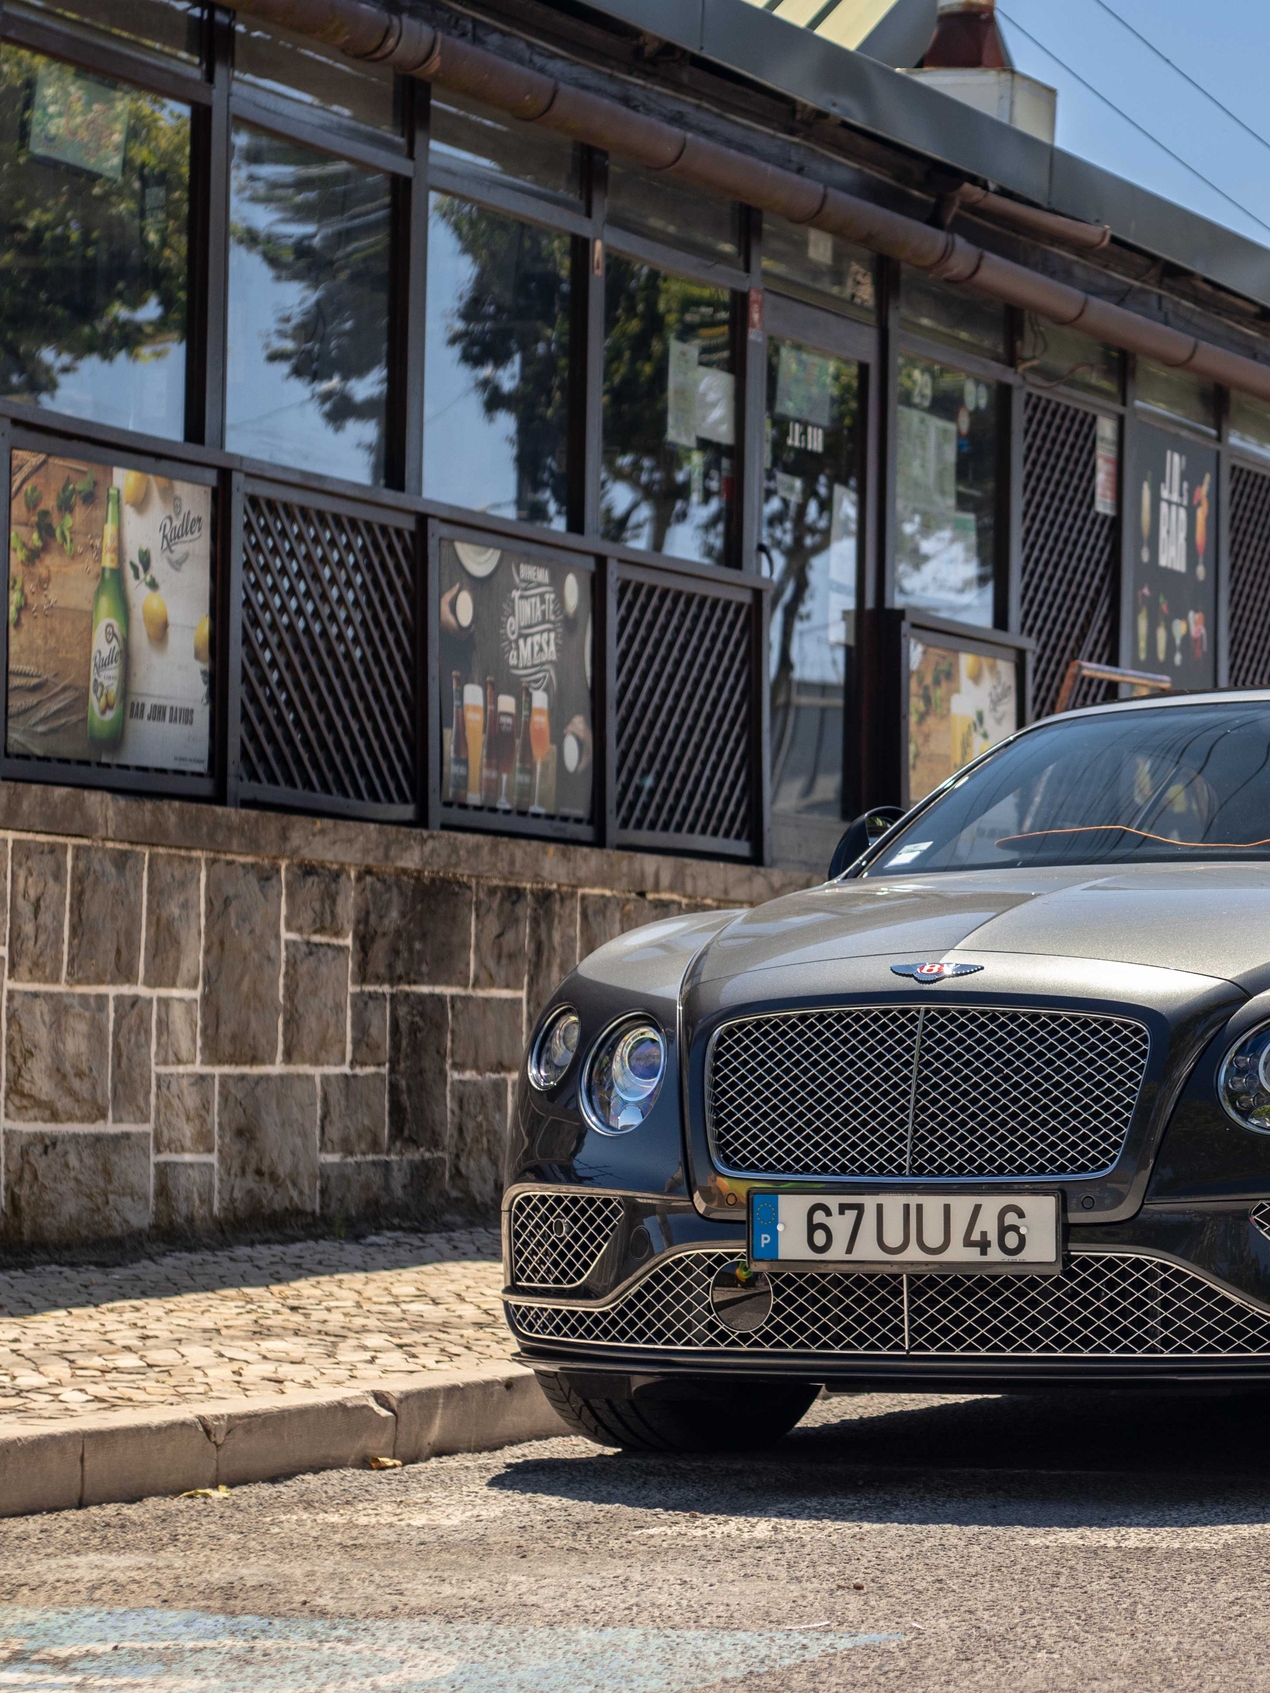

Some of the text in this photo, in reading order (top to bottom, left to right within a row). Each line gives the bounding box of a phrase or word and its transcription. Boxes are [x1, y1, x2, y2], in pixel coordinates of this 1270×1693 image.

[159, 510, 202, 554] Radler
[1158, 500, 1187, 573] BAR
[520, 562, 549, 585] BOHEMIA
[518, 631, 557, 668] MESA
[129, 701, 146, 720] BAR
[148, 702, 167, 723] JOHN
[761, 1233, 771, 1248] P
